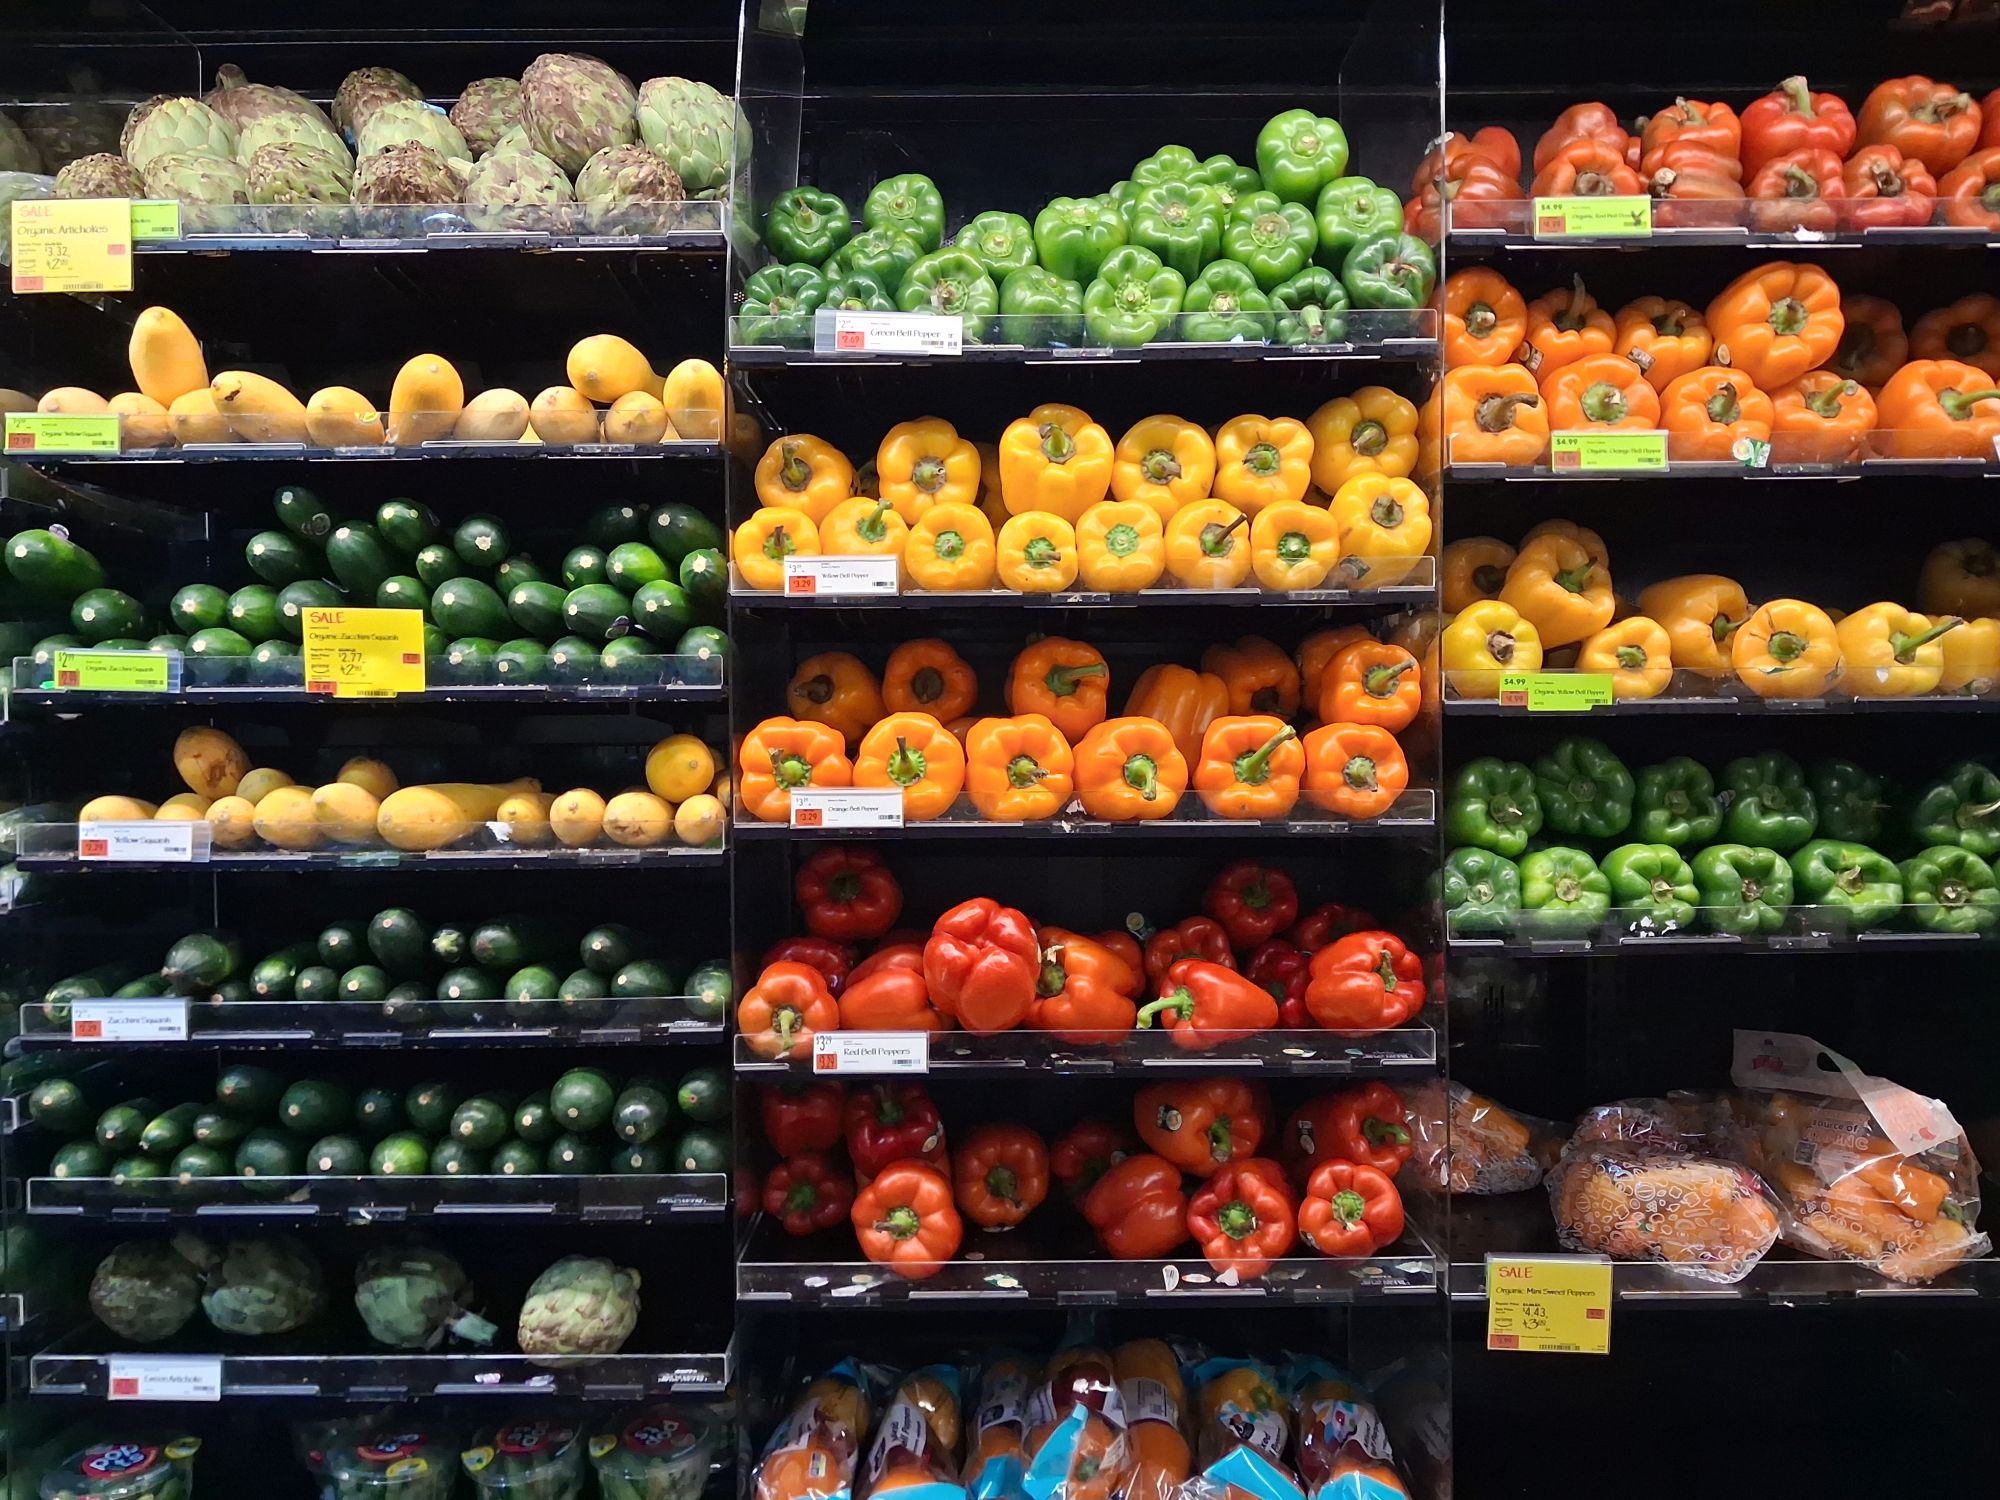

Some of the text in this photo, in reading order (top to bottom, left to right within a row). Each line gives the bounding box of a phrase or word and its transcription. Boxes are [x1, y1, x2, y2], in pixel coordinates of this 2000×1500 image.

[20, 205, 54, 217] SALE
[17, 224, 108, 237] Organic Artichokes
[871, 328, 941, 338] Green Bell Pepper
[310, 612, 346, 623] SALE
[339, 653, 362, 662] $2.77
[1499, 1266, 1533, 1278] SALE
[1496, 1287, 1523, 1295] Organic
[1523, 1308, 1546, 1317] $4.43
